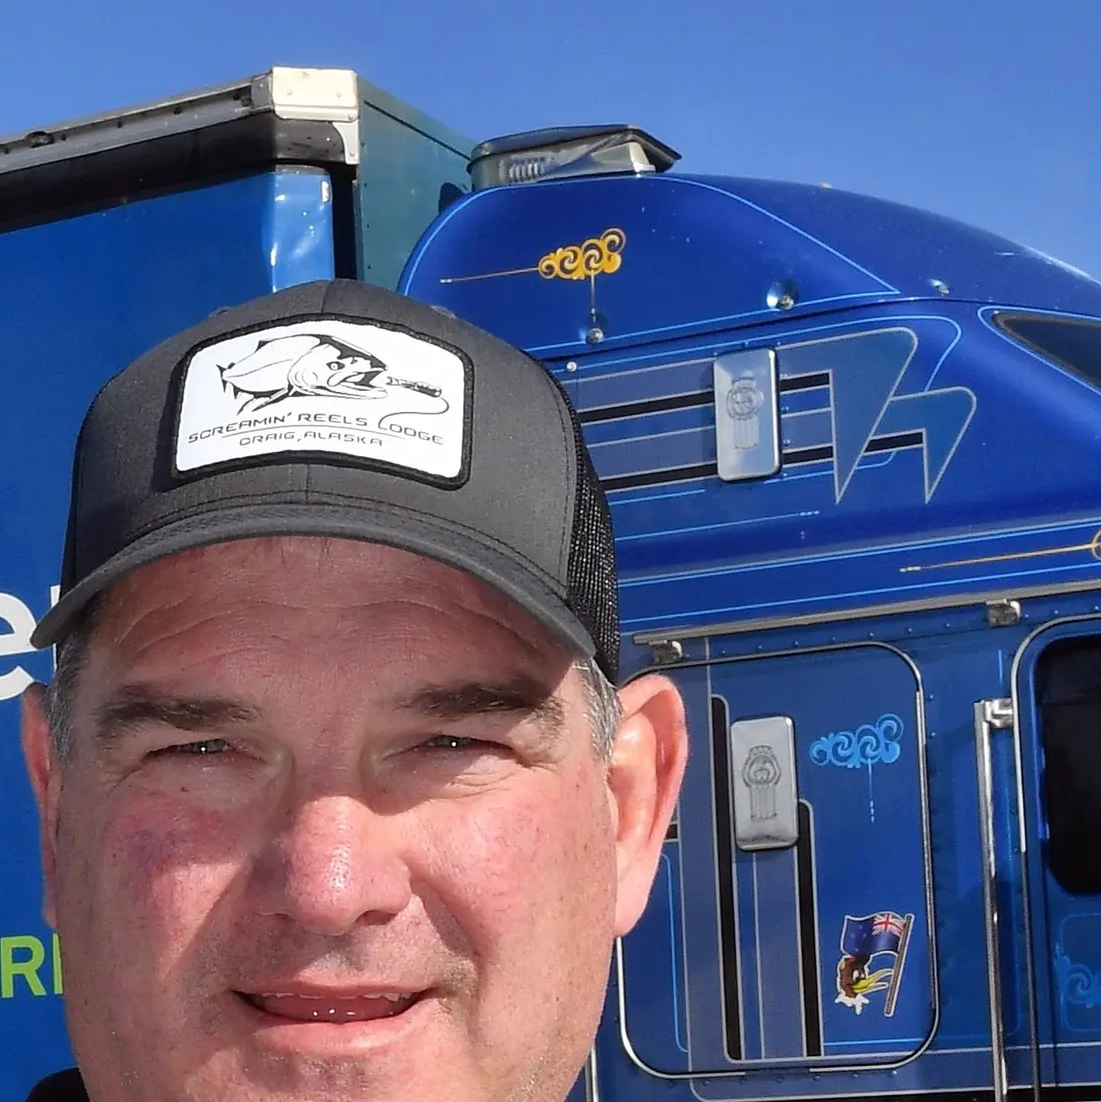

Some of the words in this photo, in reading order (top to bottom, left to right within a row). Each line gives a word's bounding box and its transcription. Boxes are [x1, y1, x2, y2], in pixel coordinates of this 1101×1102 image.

[188, 412, 292, 443] SCREAMIN'
[298, 413, 368, 427] REELS
[239, 431, 301, 446] CRAIG,
[304, 431, 382, 446] ALASKA
